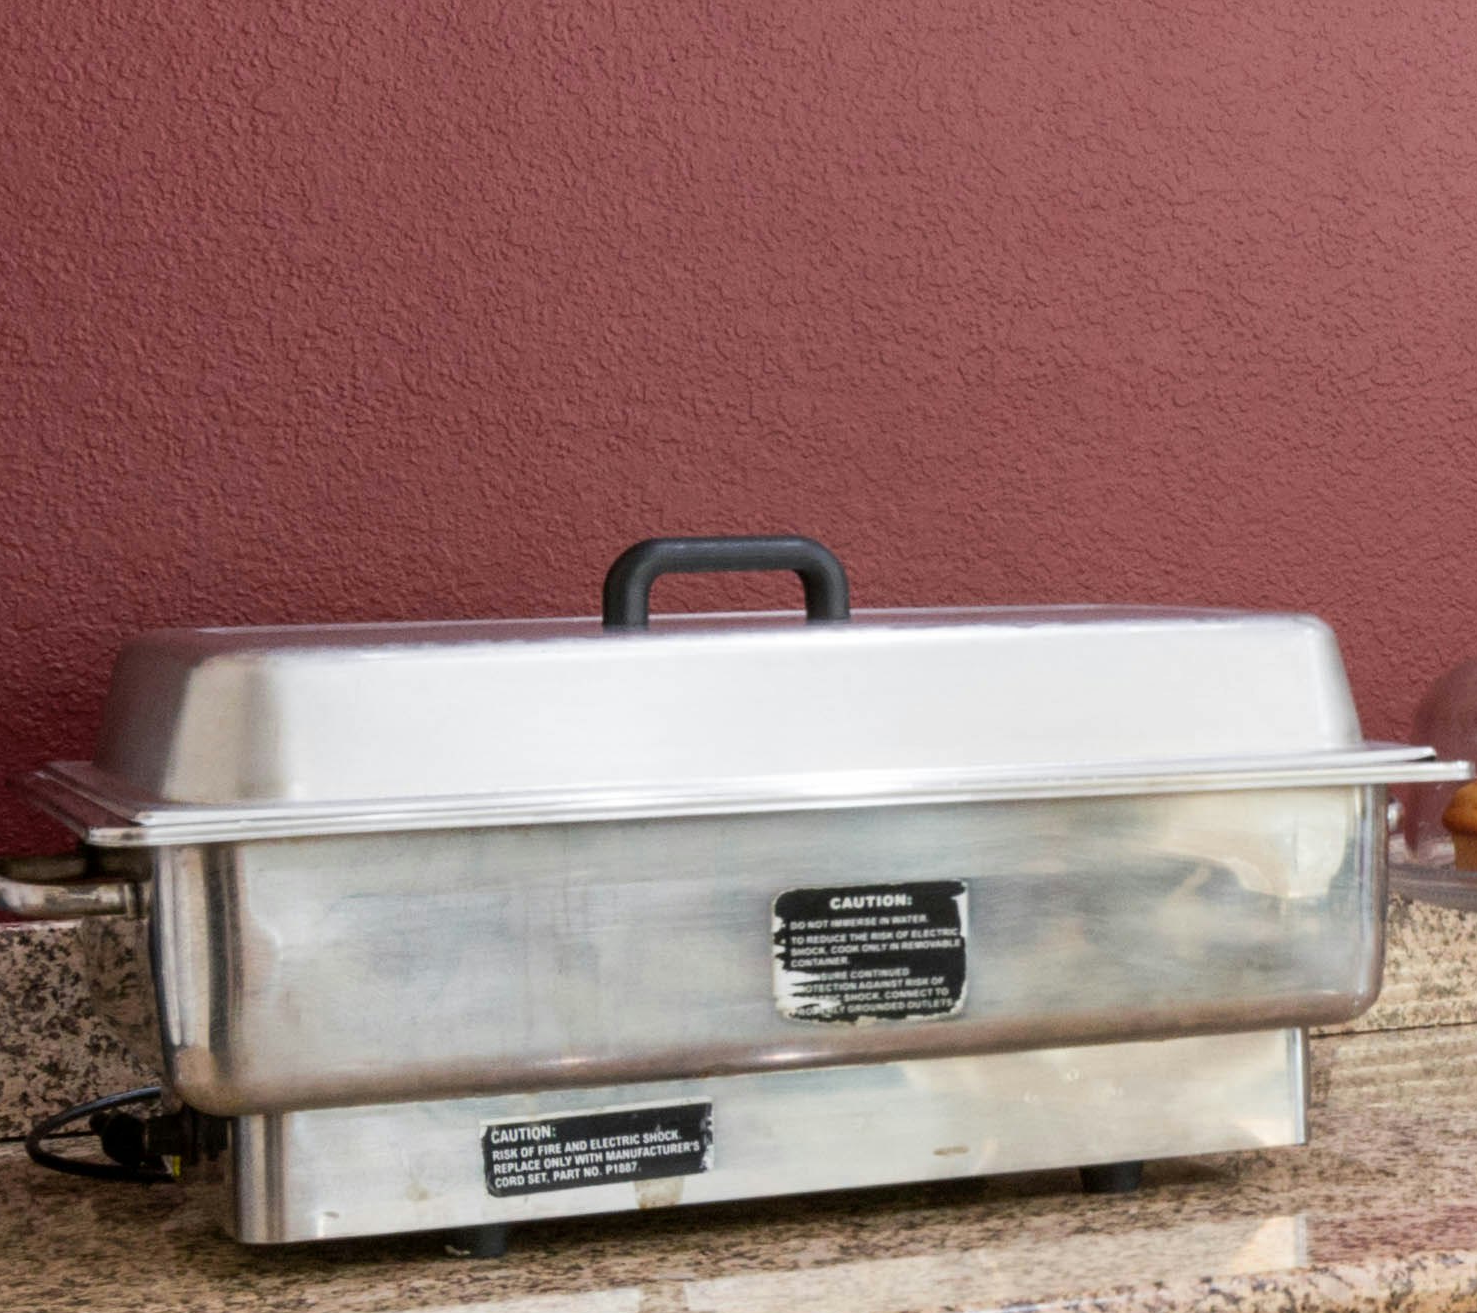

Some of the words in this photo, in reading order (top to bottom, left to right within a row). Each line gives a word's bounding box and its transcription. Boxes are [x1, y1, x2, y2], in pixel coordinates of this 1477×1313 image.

[829, 894, 913, 910] CAUTION:
[789, 921, 806, 930] DO
[807, 919, 829, 929] NOT
[830, 916, 877, 928] IMMERSE
[879, 916, 890, 926] IN
[791, 936, 805, 945] TO
[806, 934, 846, 944] REDUCE
[849, 932, 868, 942] THE
[870, 931, 893, 941] RISK
[895, 930, 909, 939] OF
[910, 927, 959, 938] ELECTRIC
[830, 945, 859, 955] COOK
[861, 943, 887, 953] ONLY
[889, 942, 900, 951] IN
[901, 938, 961, 950] REMOVABLE
[849, 967, 910, 979] CONTINUED
[858, 979, 904, 990] AGAINST
[905, 977, 929, 987] RISK
[930, 976, 945, 985] OF
[884, 988, 934, 1000] CONNECT
[935, 987, 950, 997] TO
[847, 1001, 905, 1014] GROUNDED
[490, 1124, 557, 1144] CAUTION:
[492, 1148, 518, 1161] RISK
[520, 1147, 535, 1159] OF
[537, 1145, 562, 1157] FIRE
[564, 1141, 588, 1154] AND
[589, 1137, 640, 1151] ELECTRIC
[493, 1161, 541, 1175] REPLACE
[543, 1157, 573, 1170] ONLY
[574, 1153, 603, 1166] WITH
[605, 1140, 701, 1163] MANUFACTURER'S
[494, 1175, 524, 1189] CORD
[553, 1169, 580, 1182] PART
[583, 1166, 603, 1178] NO.
